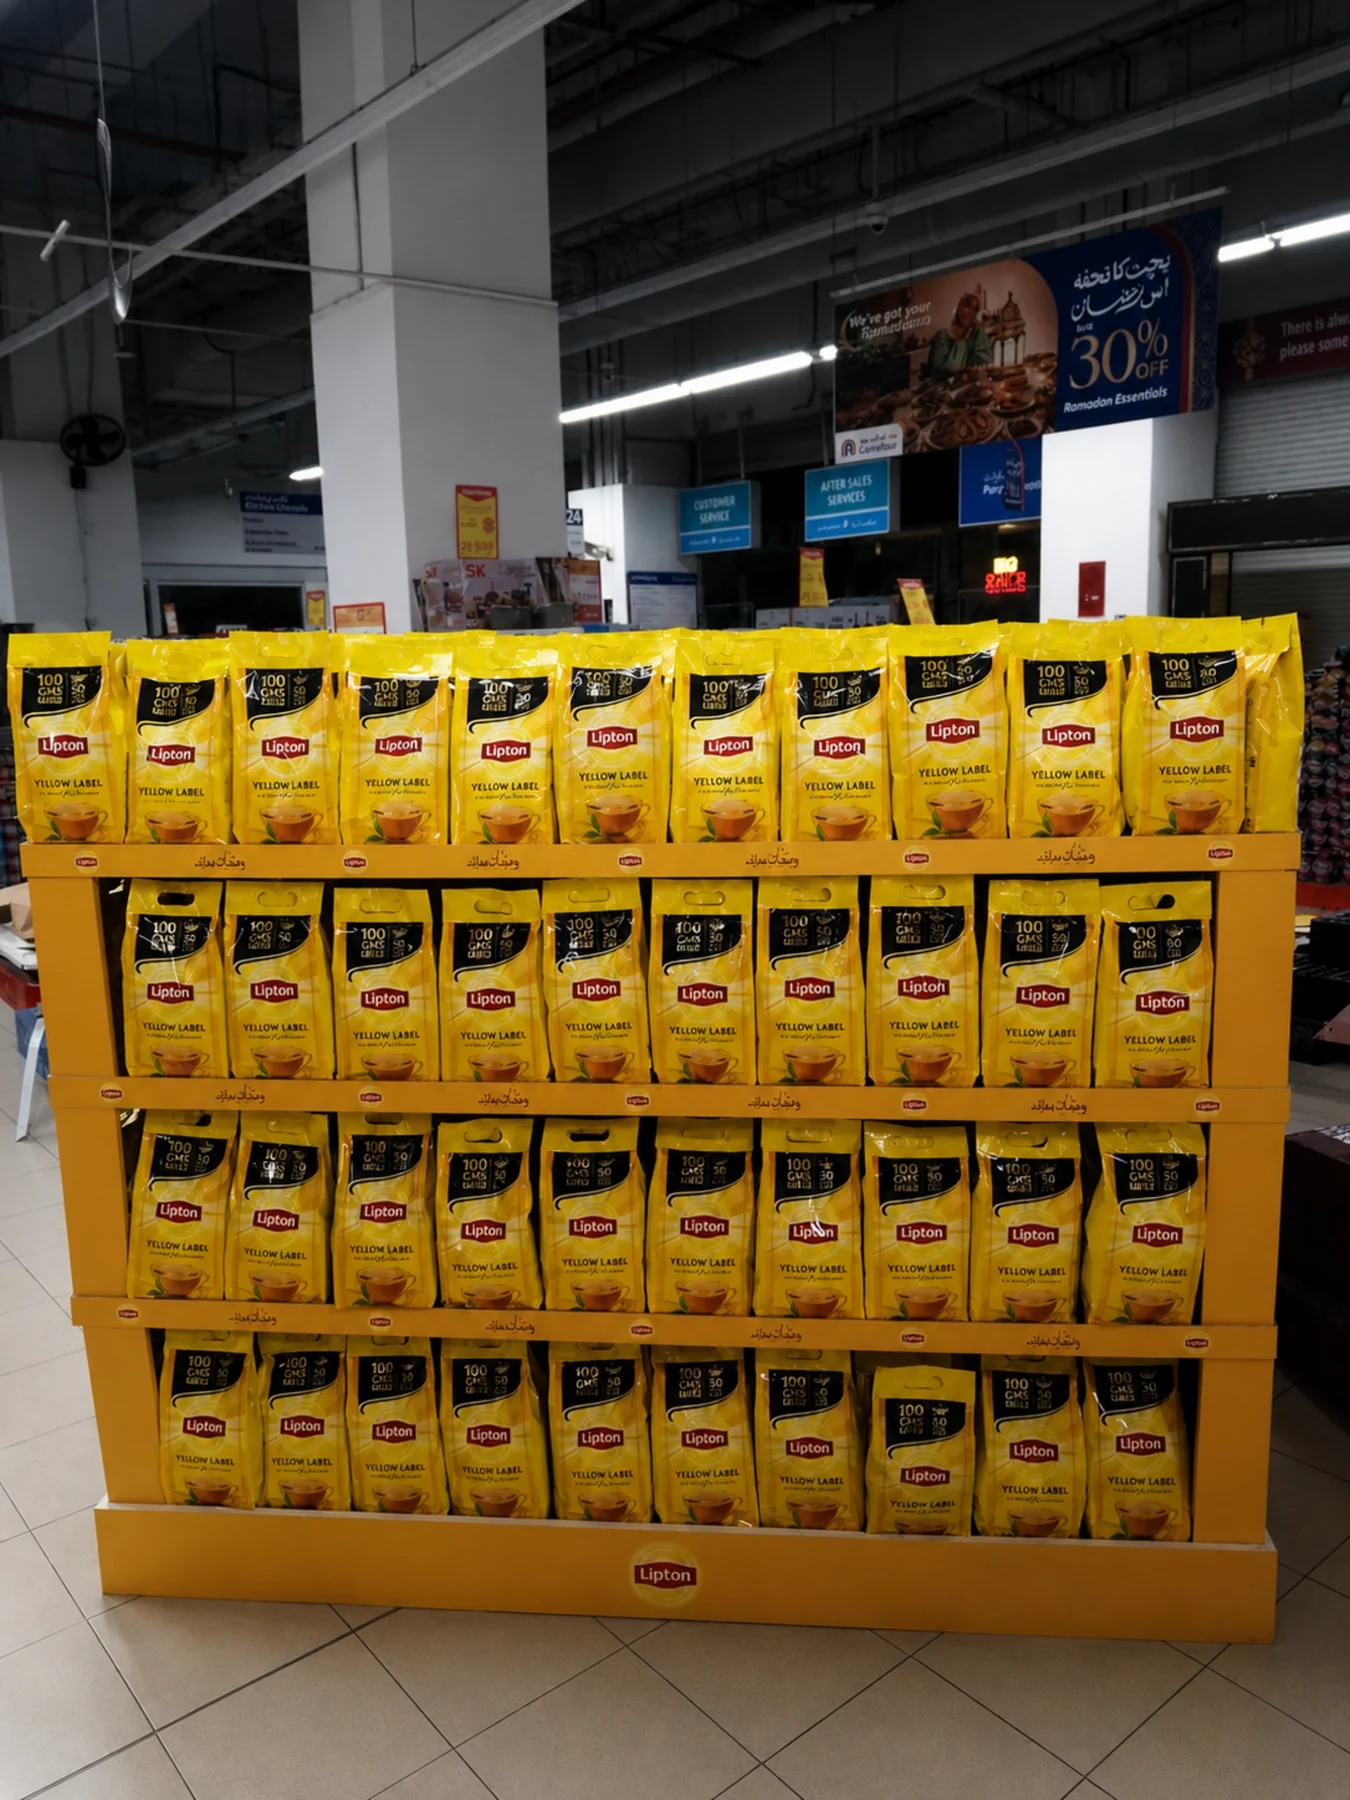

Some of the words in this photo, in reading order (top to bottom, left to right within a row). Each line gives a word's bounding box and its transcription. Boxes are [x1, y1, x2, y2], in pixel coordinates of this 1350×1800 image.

[883, 307, 902, 324] got
[904, 302, 931, 319] your
[1280, 320, 1312, 337] There
[1315, 315, 1324, 331] is
[1069, 318, 1168, 389] 30%
[1280, 341, 1316, 363] please
[1135, 359, 1169, 380] OFF
[1114, 386, 1168, 406] Essentials
[821, 478, 846, 492] AFTER
[847, 474, 872, 488] SALES
[694, 495, 736, 511] CUSTOMER
[827, 490, 866, 507] SERVICES
[566, 510, 582, 524] 24
[700, 510, 730, 525] SERVICE
[466, 564, 486, 578] SK
[1037, 665, 1065, 677] 100
[1162, 658, 1189, 671] 100
[37, 674, 63, 687] 100
[261, 674, 286, 687] 100
[813, 676, 838, 690] 100
[156, 687, 180, 699] 100
[929, 722, 975, 739] Lipton
[1046, 727, 1090, 743] Lipton
[1174, 720, 1219, 737] Lipton
[590, 729, 633, 747] Lipton
[266, 741, 305, 757] Lipton
[378, 738, 418, 754] Lipton
[484, 743, 526, 758] Lipton
[707, 739, 749, 754] Lipton
[817, 739, 861, 757] Lipton
[152, 748, 191, 764] Lipton
[579, 771, 616, 782] YELLOW
[620, 770, 648, 781] LABEL
[919, 766, 958, 778] YELLOW
[962, 764, 991, 776] LABEL
[1032, 769, 1072, 780] YELLOW
[1076, 769, 1105, 780] LABEL
[1159, 765, 1200, 776] YELLOW
[1203, 764, 1232, 775] LABEL
[34, 778, 70, 789] YELLOW
[74, 778, 103, 789] LABEL
[253, 780, 289, 791] YELLOW
[292, 780, 319, 791] LABEL
[366, 777, 401, 788] YELLOW
[403, 777, 431, 787] LABEL
[472, 782, 508, 792] YELLOW
[512, 781, 540, 791] LABEL
[694, 776, 732, 787] YELLOW
[735, 775, 764, 786] LABEL
[805, 780, 843, 792] YELLOW
[847, 780, 876, 791] LABEL
[139, 786, 173, 797] YELLOW
[176, 787, 205, 798] LABEL
[151, 986, 190, 1000] Lipton
[254, 985, 294, 999] Lipton
[577, 984, 617, 998] Lipton
[682, 988, 723, 1001] Lipton
[789, 980, 832, 997] Lipton
[903, 981, 946, 996] Lipton
[365, 993, 405, 1007] Lipton
[471, 993, 511, 1007] Lipton
[1021, 989, 1065, 1004] Lipton
[1140, 995, 1187, 1011] Lipton
[143, 1022, 176, 1032] YELLOW
[178, 1023, 206, 1033] LABEL
[244, 1022, 279, 1033] YELLOW
[282, 1023, 309, 1033] LABEL
[566, 1022, 602, 1032] YELLOW
[605, 1021, 632, 1032] LABEL
[670, 1026, 706, 1037] YELLOW
[709, 1026, 737, 1036] LABEL
[776, 1022, 813, 1032] YELLOW
[816, 1022, 845, 1032] LABEL
[890, 1021, 928, 1031] YELLOW
[931, 1020, 960, 1031] LABEL
[353, 1030, 390, 1040] YELLOW
[393, 1030, 420, 1041] LABEL
[461, 1031, 496, 1041] YELLOW
[499, 1030, 527, 1041] LABEL
[1006, 1027, 1046, 1038] YELLOW
[1049, 1028, 1077, 1039] LABEL
[1124, 1035, 1165, 1045] YELLOW
[1168, 1034, 1197, 1045] LABEL
[160, 1204, 198, 1218] Lipton
[364, 1206, 403, 1219] Lipton
[257, 1212, 295, 1227] Lipton
[465, 1225, 502, 1238] Lipton
[573, 1221, 613, 1234] Lipton
[684, 1220, 725, 1234] Lipton
[901, 1227, 943, 1240] Lipton
[1013, 1229, 1055, 1243] Lipton
[1137, 1228, 1178, 1242] Lipton
[148, 1240, 180, 1252] YELLOW
[182, 1242, 209, 1253] LABEL
[350, 1244, 384, 1254] YELLOW
[388, 1244, 414, 1255] LABEL
[245, 1248, 277, 1260] YELLOW
[280, 1250, 306, 1260] LABEL
[452, 1263, 488, 1273] YELLOW
[490, 1261, 518, 1272] LABEL
[562, 1258, 598, 1268] YELLOW
[600, 1257, 628, 1267] LABEL
[671, 1257, 707, 1268] YELLOW
[709, 1257, 736, 1268] LABEL
[780, 1264, 817, 1274] YELLOW
[819, 1264, 847, 1274] LABEL
[888, 1264, 926, 1274] YELLOW
[929, 1263, 956, 1274] LABEL
[998, 1266, 1036, 1277] YELLOW
[1039, 1267, 1066, 1277] LABEL
[1120, 1265, 1159, 1276] YELLOW
[1162, 1267, 1188, 1278] LABEL
[187, 1419, 222, 1433] Lipton
[284, 1420, 321, 1433] Lipton
[376, 1425, 411, 1439] Lipton
[471, 1429, 507, 1442] Lipton
[582, 1432, 620, 1446] Lipton
[686, 1433, 724, 1446] Lipton
[791, 1443, 829, 1454] Lipton
[1014, 1444, 1053, 1458] Lipton
[1121, 1437, 1161, 1452] Lipton
[906, 1469, 945, 1482] Lipton
[640, 1567, 691, 1584] Lipton
